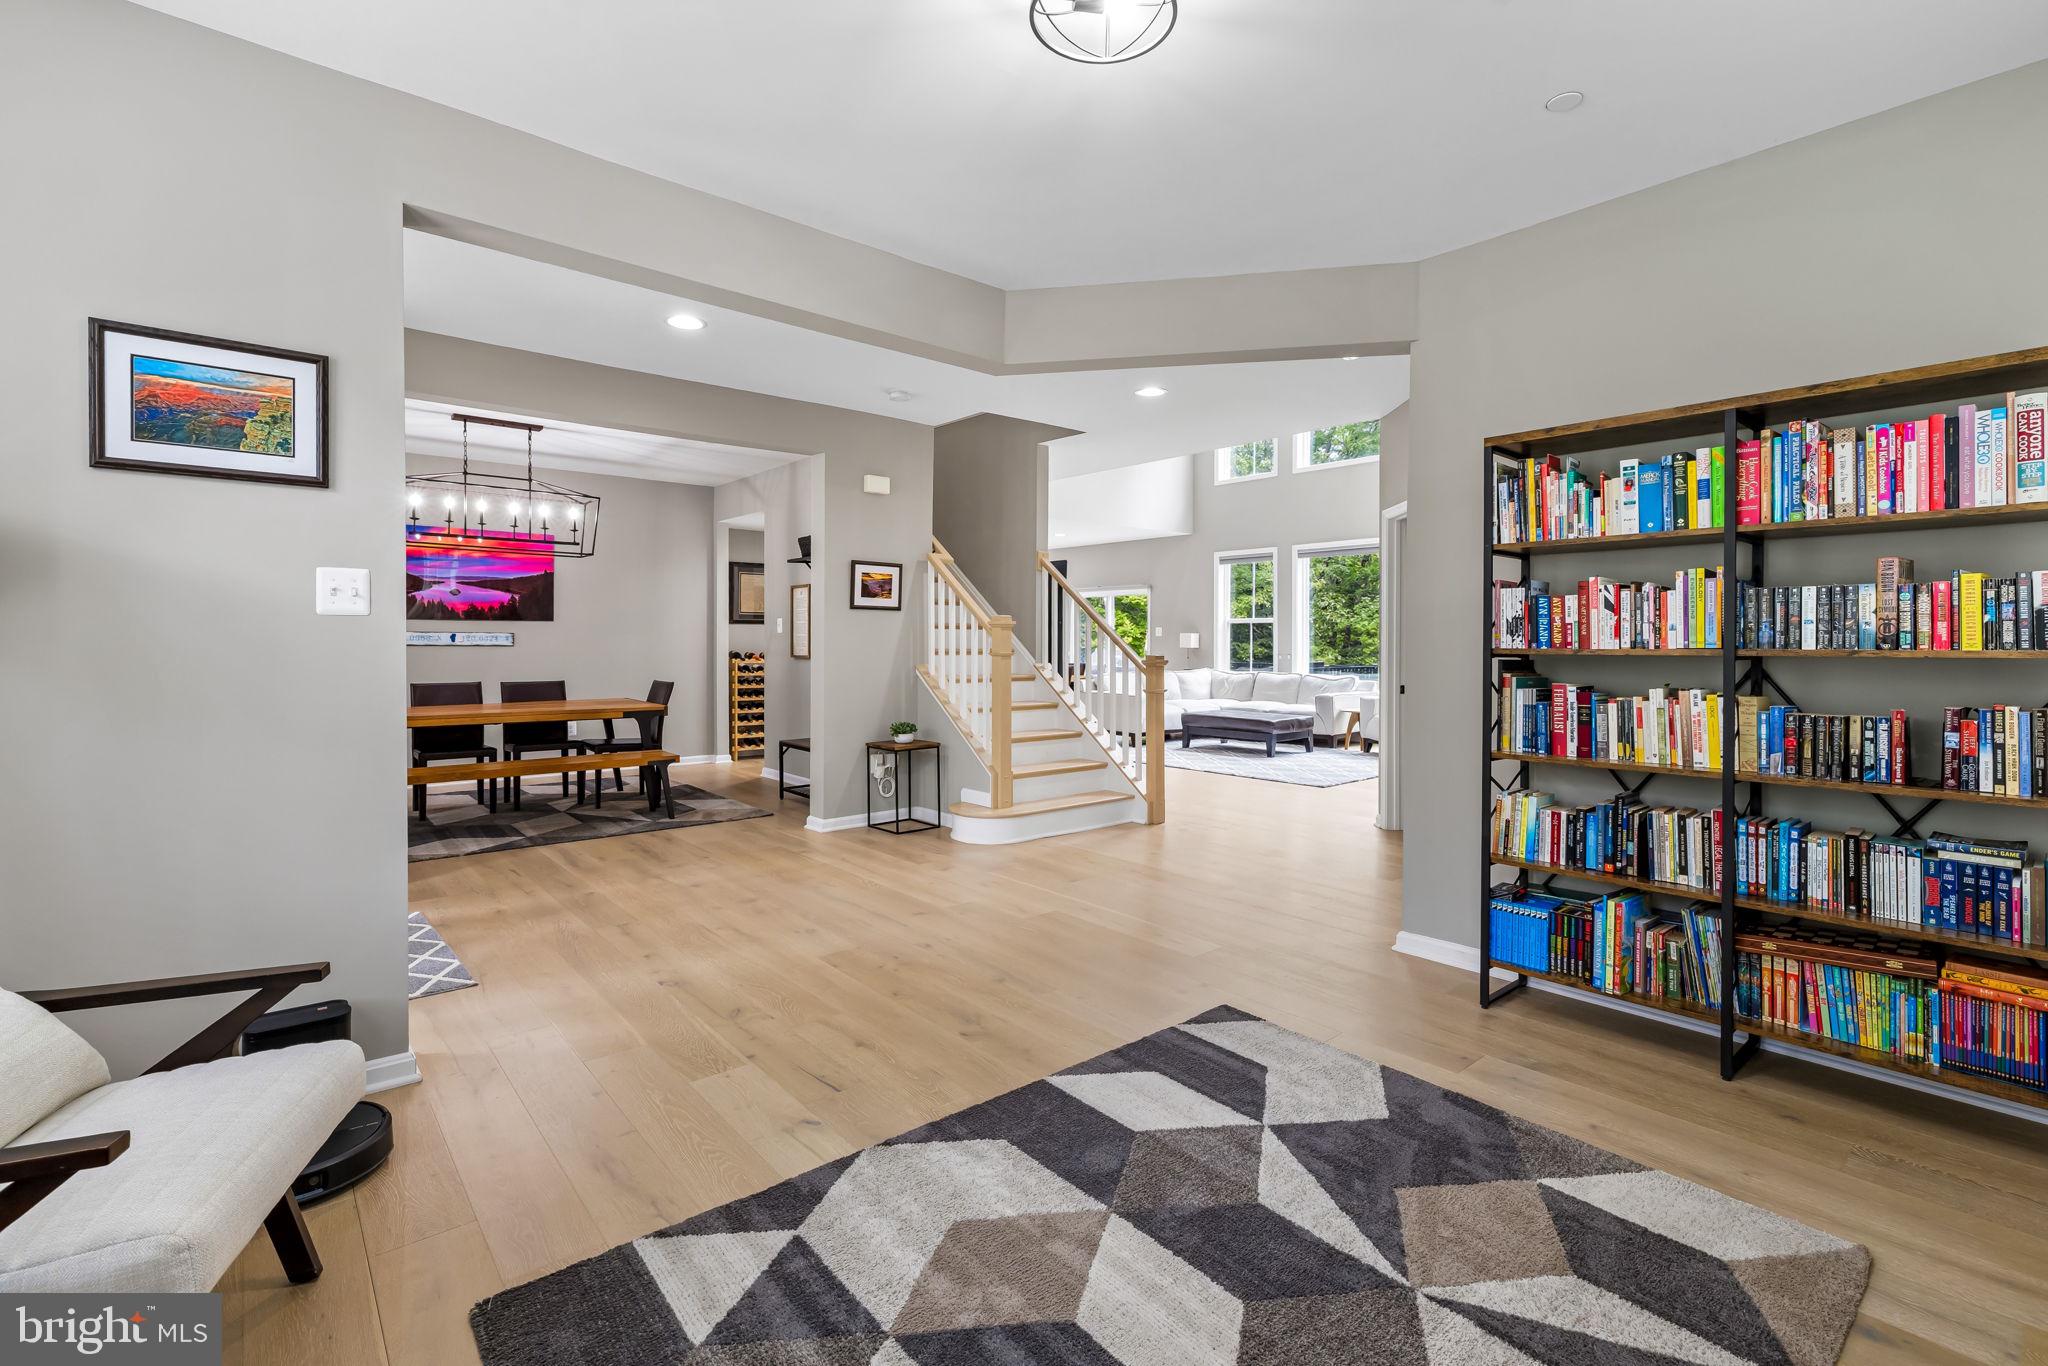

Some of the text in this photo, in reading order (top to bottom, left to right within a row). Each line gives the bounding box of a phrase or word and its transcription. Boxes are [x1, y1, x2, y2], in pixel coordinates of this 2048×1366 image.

[1977, 413, 1991, 464] WHOLE30
[2019, 412, 2028, 460] CAN COOK
[2029, 410, 2043, 459] anyone
[1736, 459, 1749, 501] Everything
[1748, 457, 1758, 474] How
[1792, 437, 1800, 504] PRACTICAL PALEO
[1867, 450, 1877, 492] Let's Cook!
[1879, 451, 1888, 494] Kids Cookbook
[1932, 464, 1940, 483] Family
[1995, 452, 2003, 491] COOKBOOK
[1748, 481, 1758, 499] Cook
[1881, 560, 1894, 592] DAN BROWN
[1539, 598, 1548, 642] AYN RAND
[1553, 597, 1562, 643] AYN RAND
[1899, 600, 1911, 631] DAN BROWN
[1965, 579, 1978, 641] MICHAEL CRICHTON
[1554, 689, 1564, 734] FEDERALIST
[1995, 711, 2003, 732] JARHEAD
[2037, 718, 2045, 732] Flash
[1879, 723, 1889, 759] BLINDSIGHT
[1945, 749, 1953, 763] STEEL
[2036, 738, 2045, 755] Genius
[1961, 764, 1969, 781] CAUSE
[1970, 847, 2020, 859] ENDER'S GAME
[1965, 896, 1973, 924] XENOCIDE
